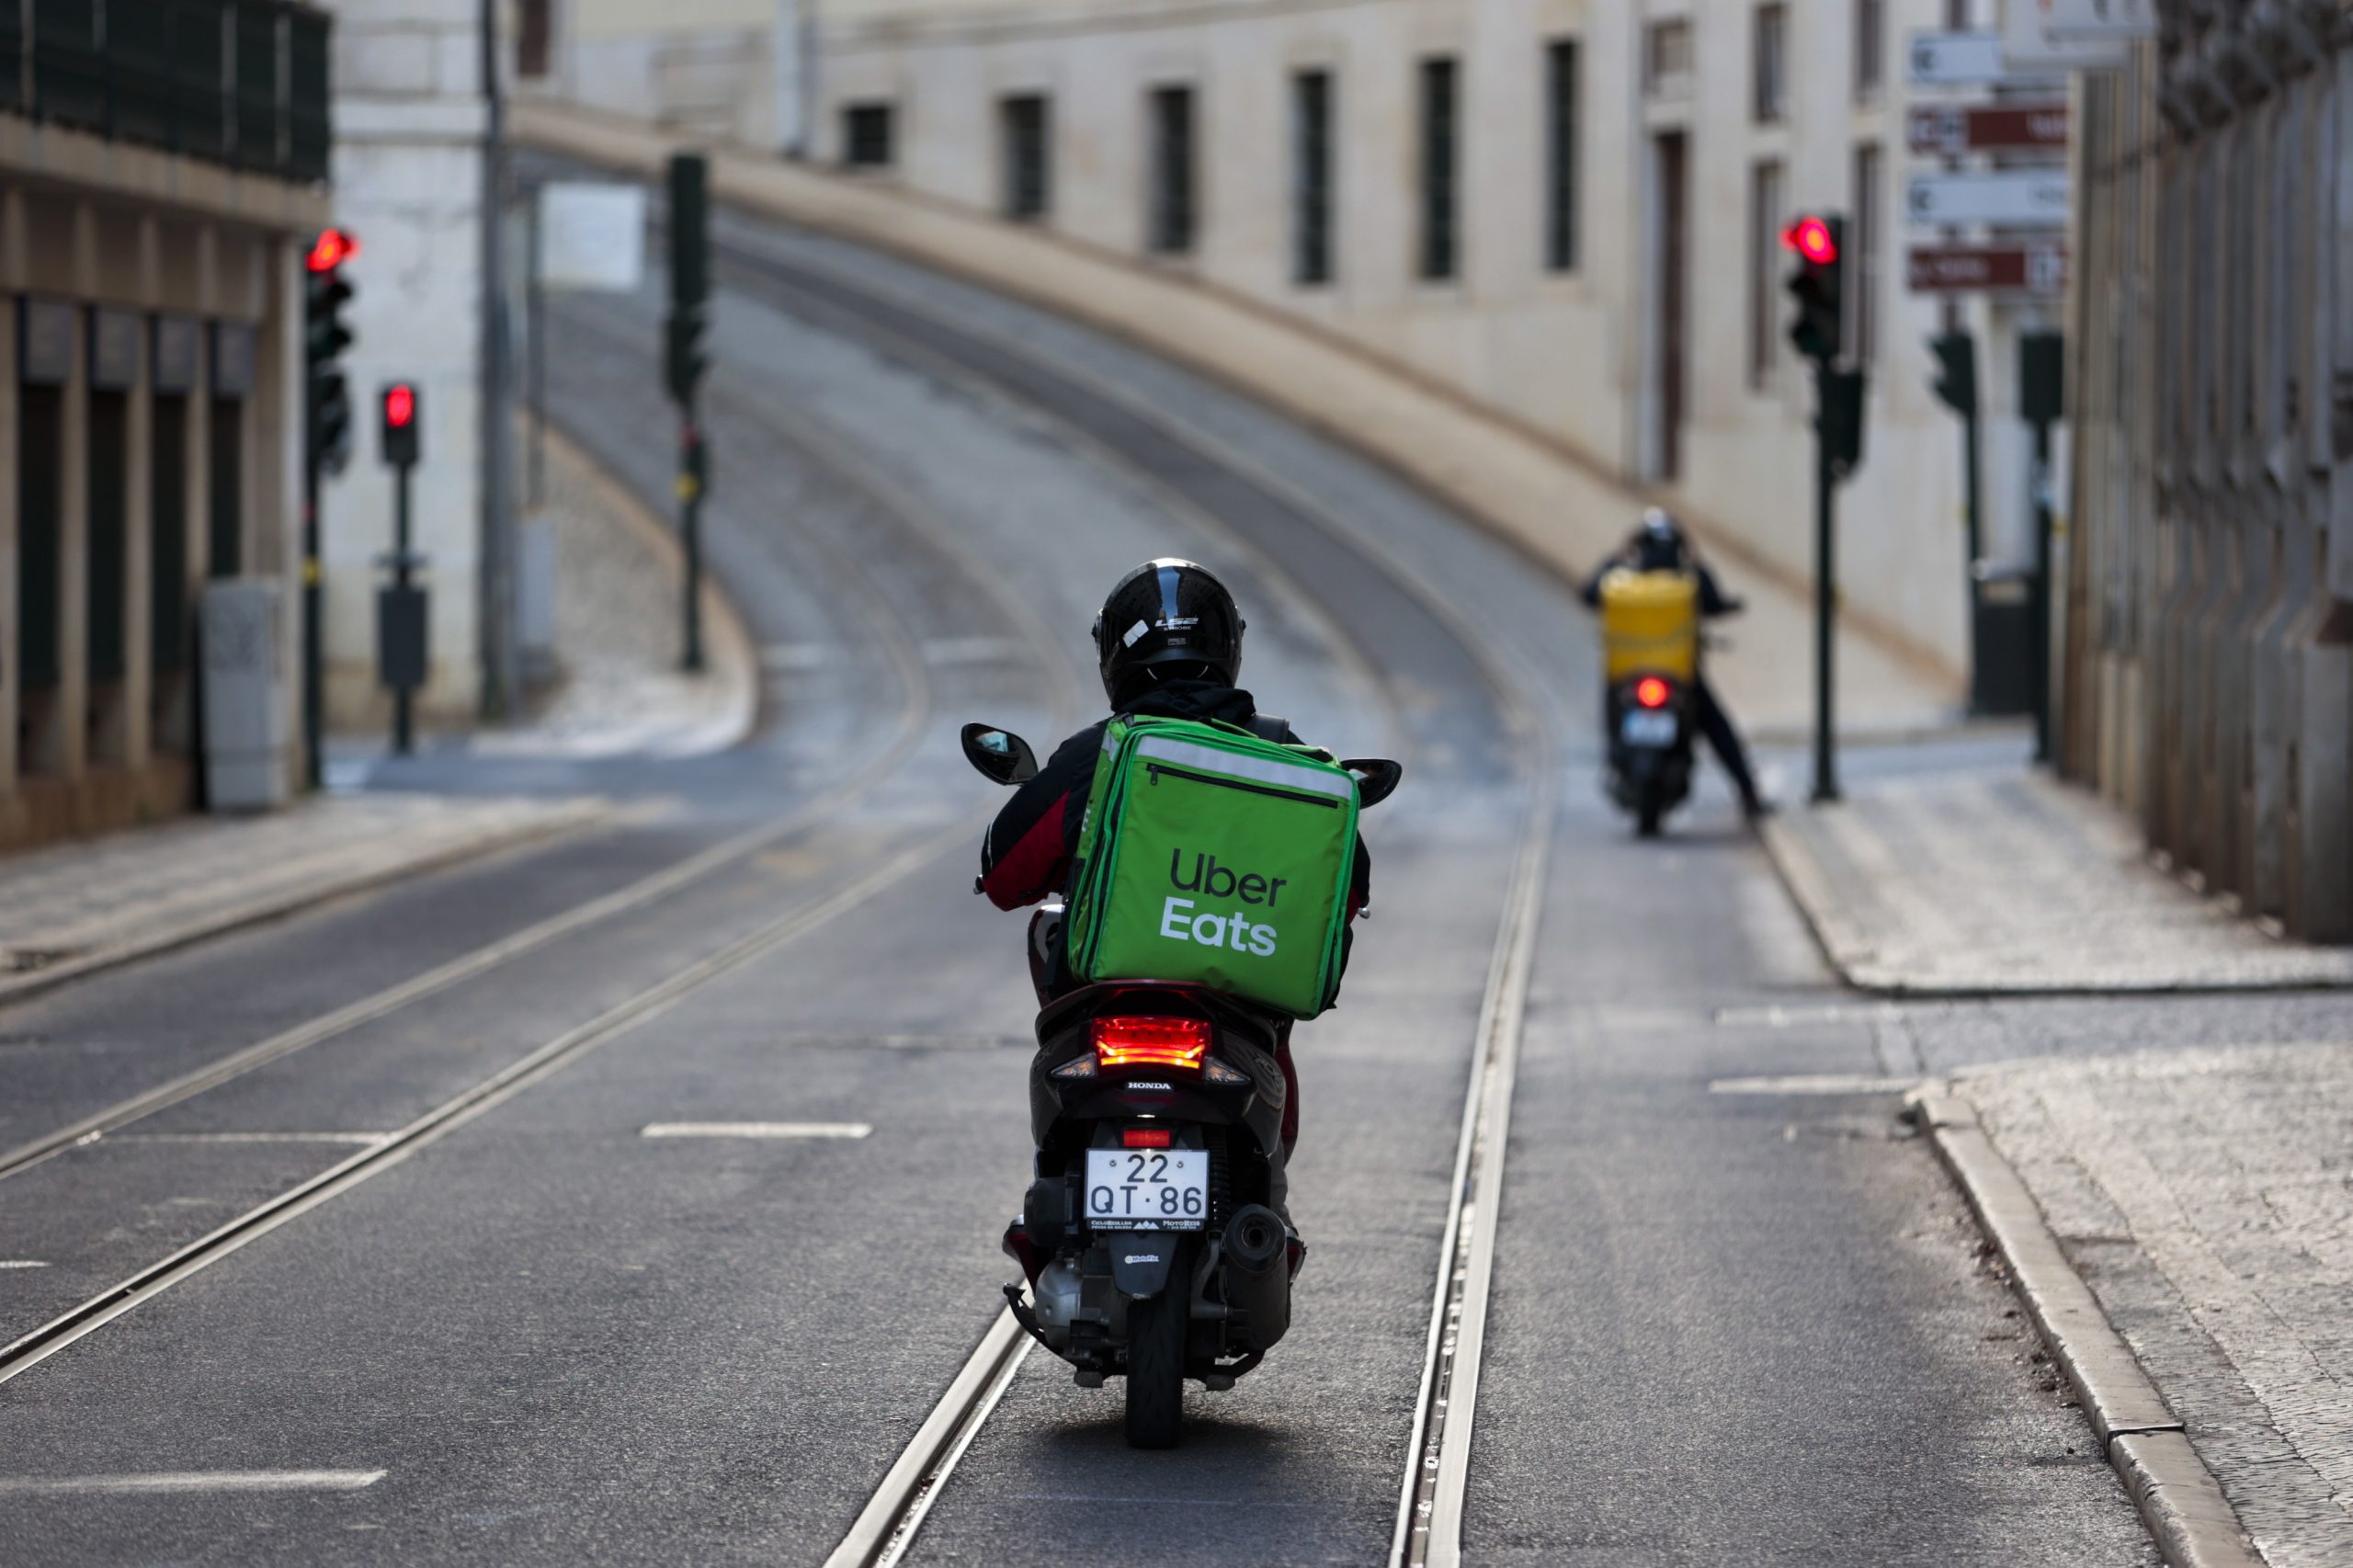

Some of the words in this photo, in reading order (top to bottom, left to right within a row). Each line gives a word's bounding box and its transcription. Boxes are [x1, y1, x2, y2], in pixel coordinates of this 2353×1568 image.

[1154, 617, 1199, 627] LS2
[1169, 847, 1287, 907] Uber
[1159, 896, 1278, 957] Eats
[1128, 1082, 1172, 1090] HONDA
[1126, 1153, 1168, 1183] 22
